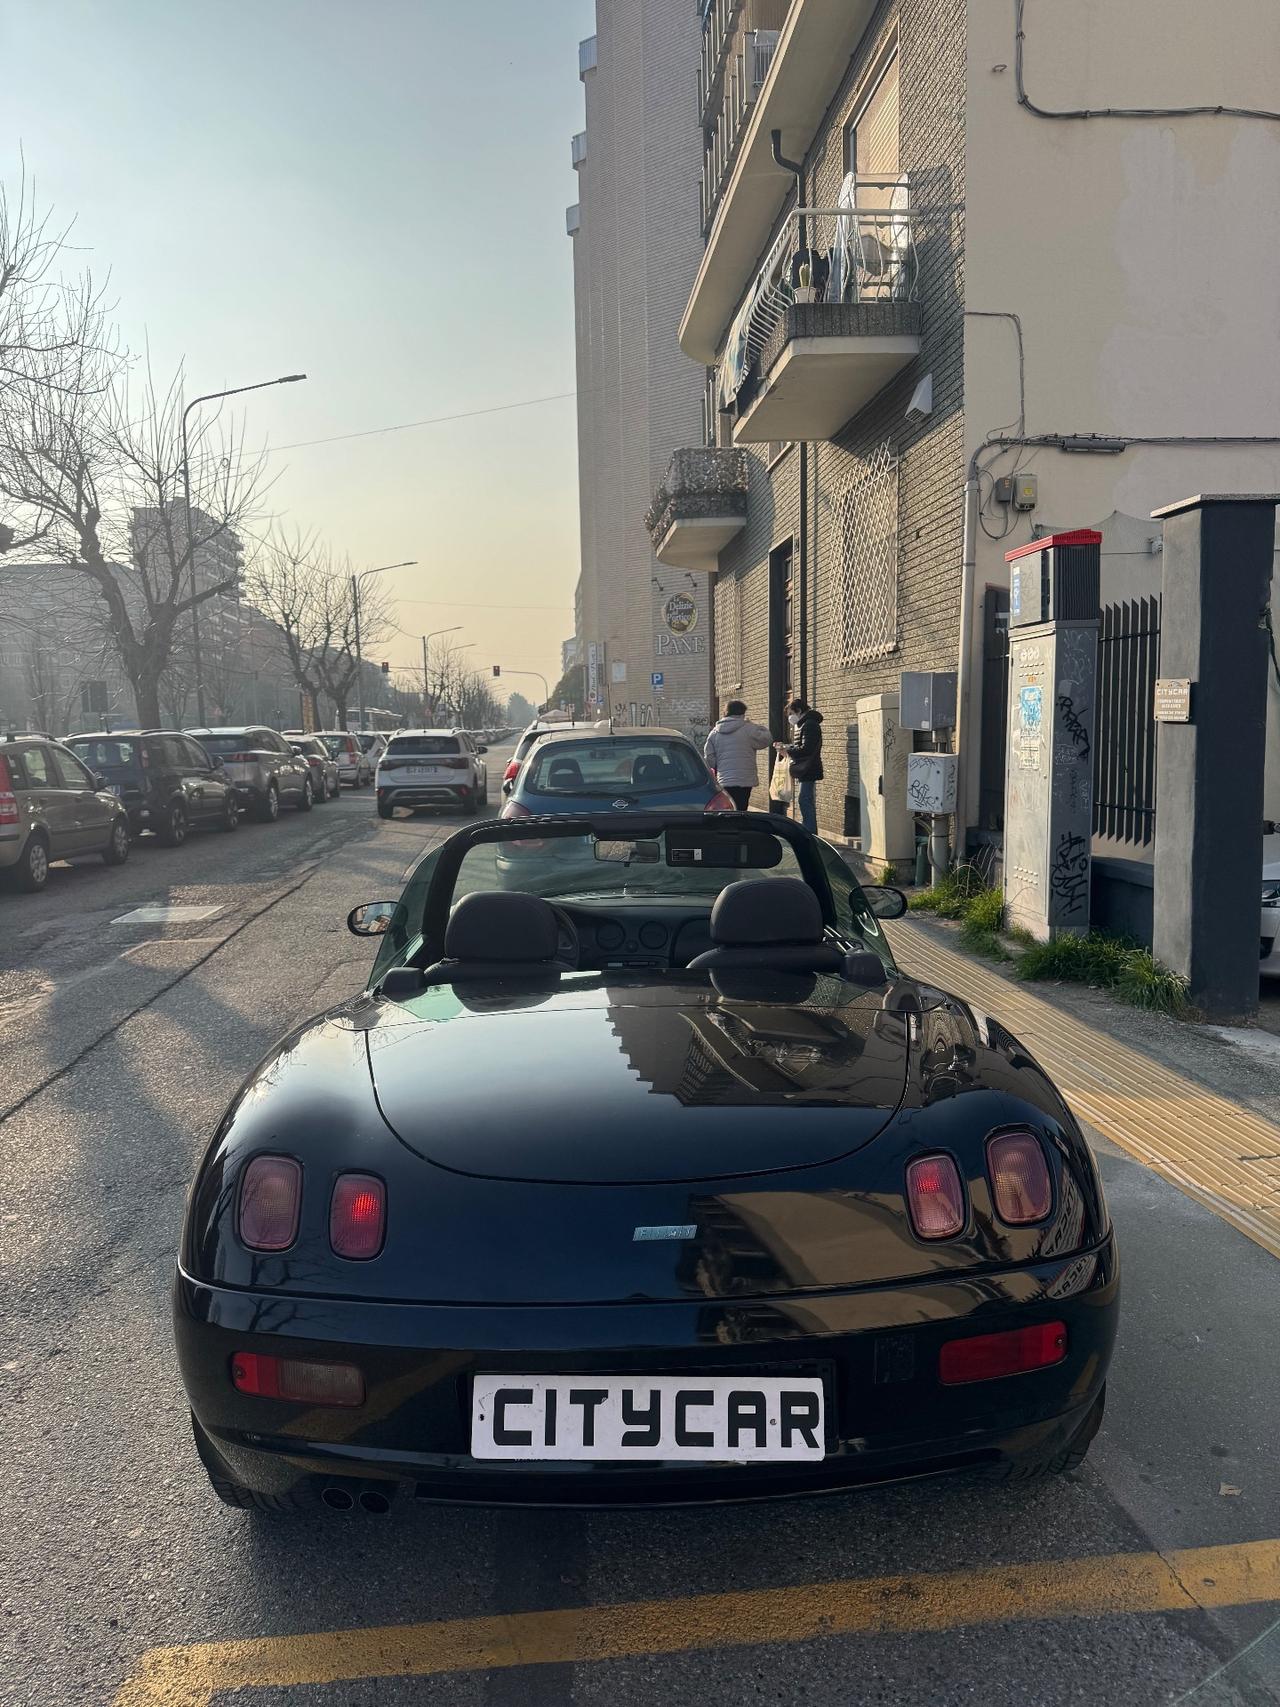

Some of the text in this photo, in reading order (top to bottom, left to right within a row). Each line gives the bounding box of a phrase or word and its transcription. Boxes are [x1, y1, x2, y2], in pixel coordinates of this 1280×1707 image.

[656, 634, 705, 656] PANE
[653, 673, 662, 684] P
[1157, 688, 1188, 696] CITYCAR
[493, 1388, 820, 1449] CITYCAR
